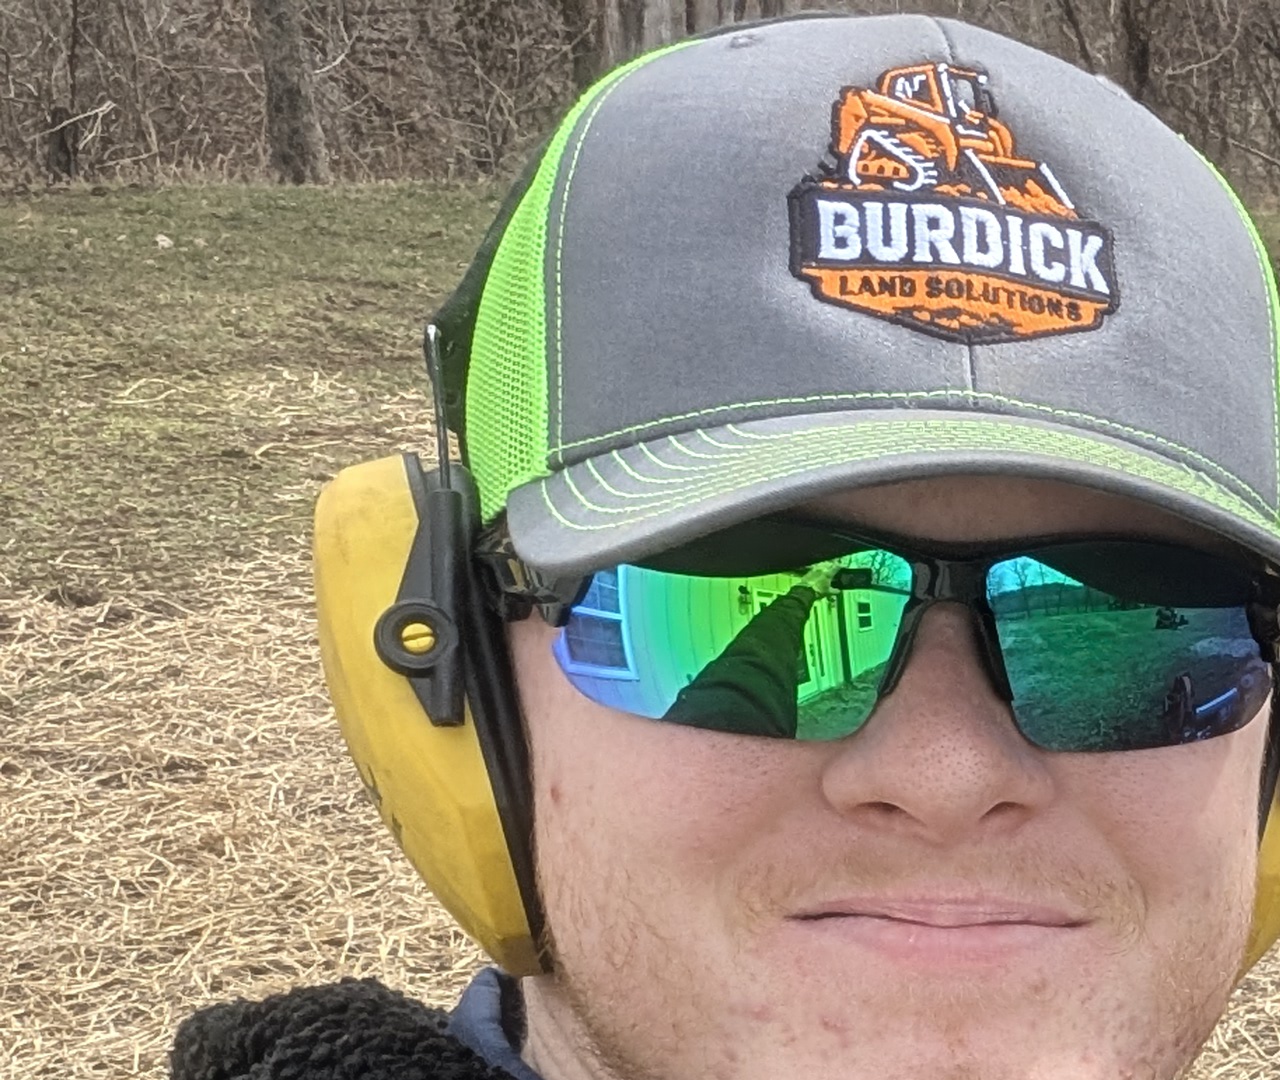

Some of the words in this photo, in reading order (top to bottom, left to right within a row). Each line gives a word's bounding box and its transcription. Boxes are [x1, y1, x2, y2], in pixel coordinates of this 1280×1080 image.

[817, 199, 1111, 294] BURDICK
[839, 275, 917, 299] LAND
[925, 276, 1083, 321] SOLUTIONS
